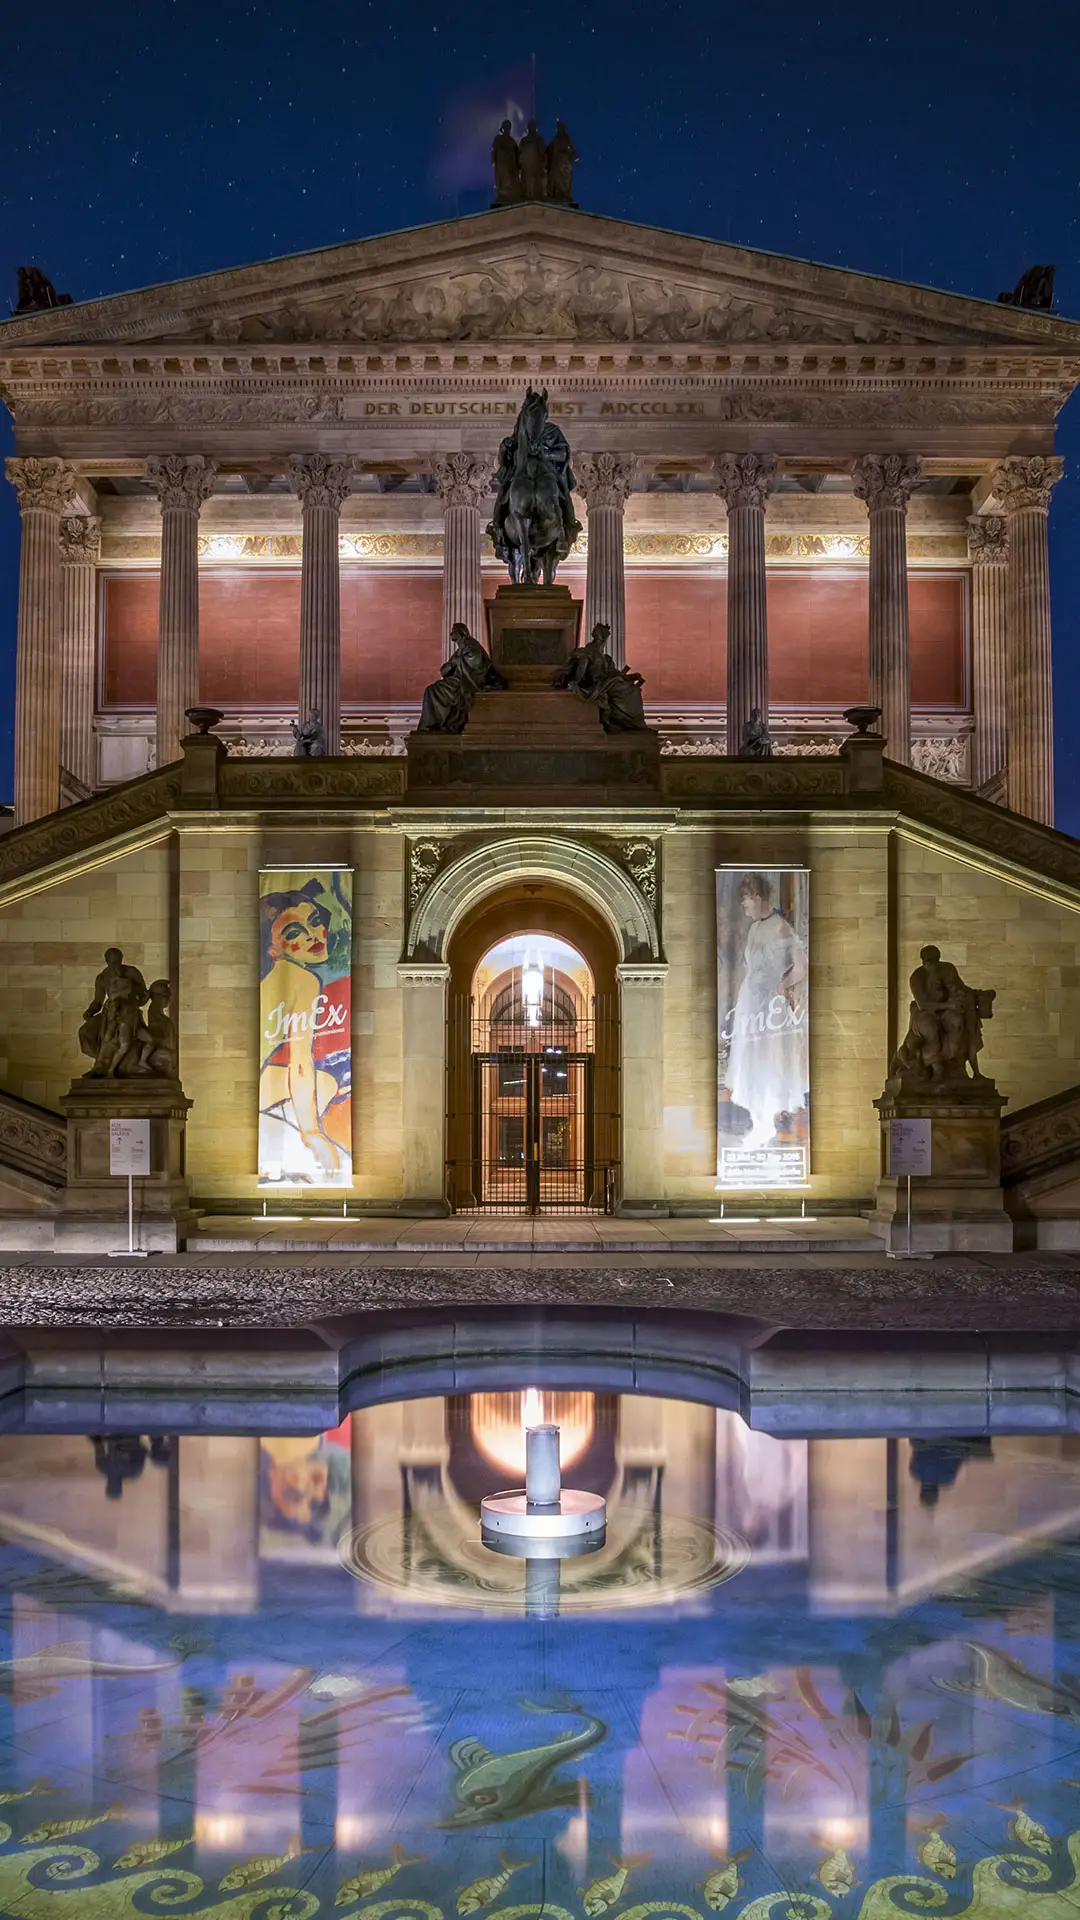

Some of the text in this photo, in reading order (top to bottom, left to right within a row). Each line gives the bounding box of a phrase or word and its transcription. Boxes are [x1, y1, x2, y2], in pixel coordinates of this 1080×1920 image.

[364, 402, 400, 415] DER
[410, 402, 518, 415] DEUTSCHEN
[547, 402, 586, 415] NST
